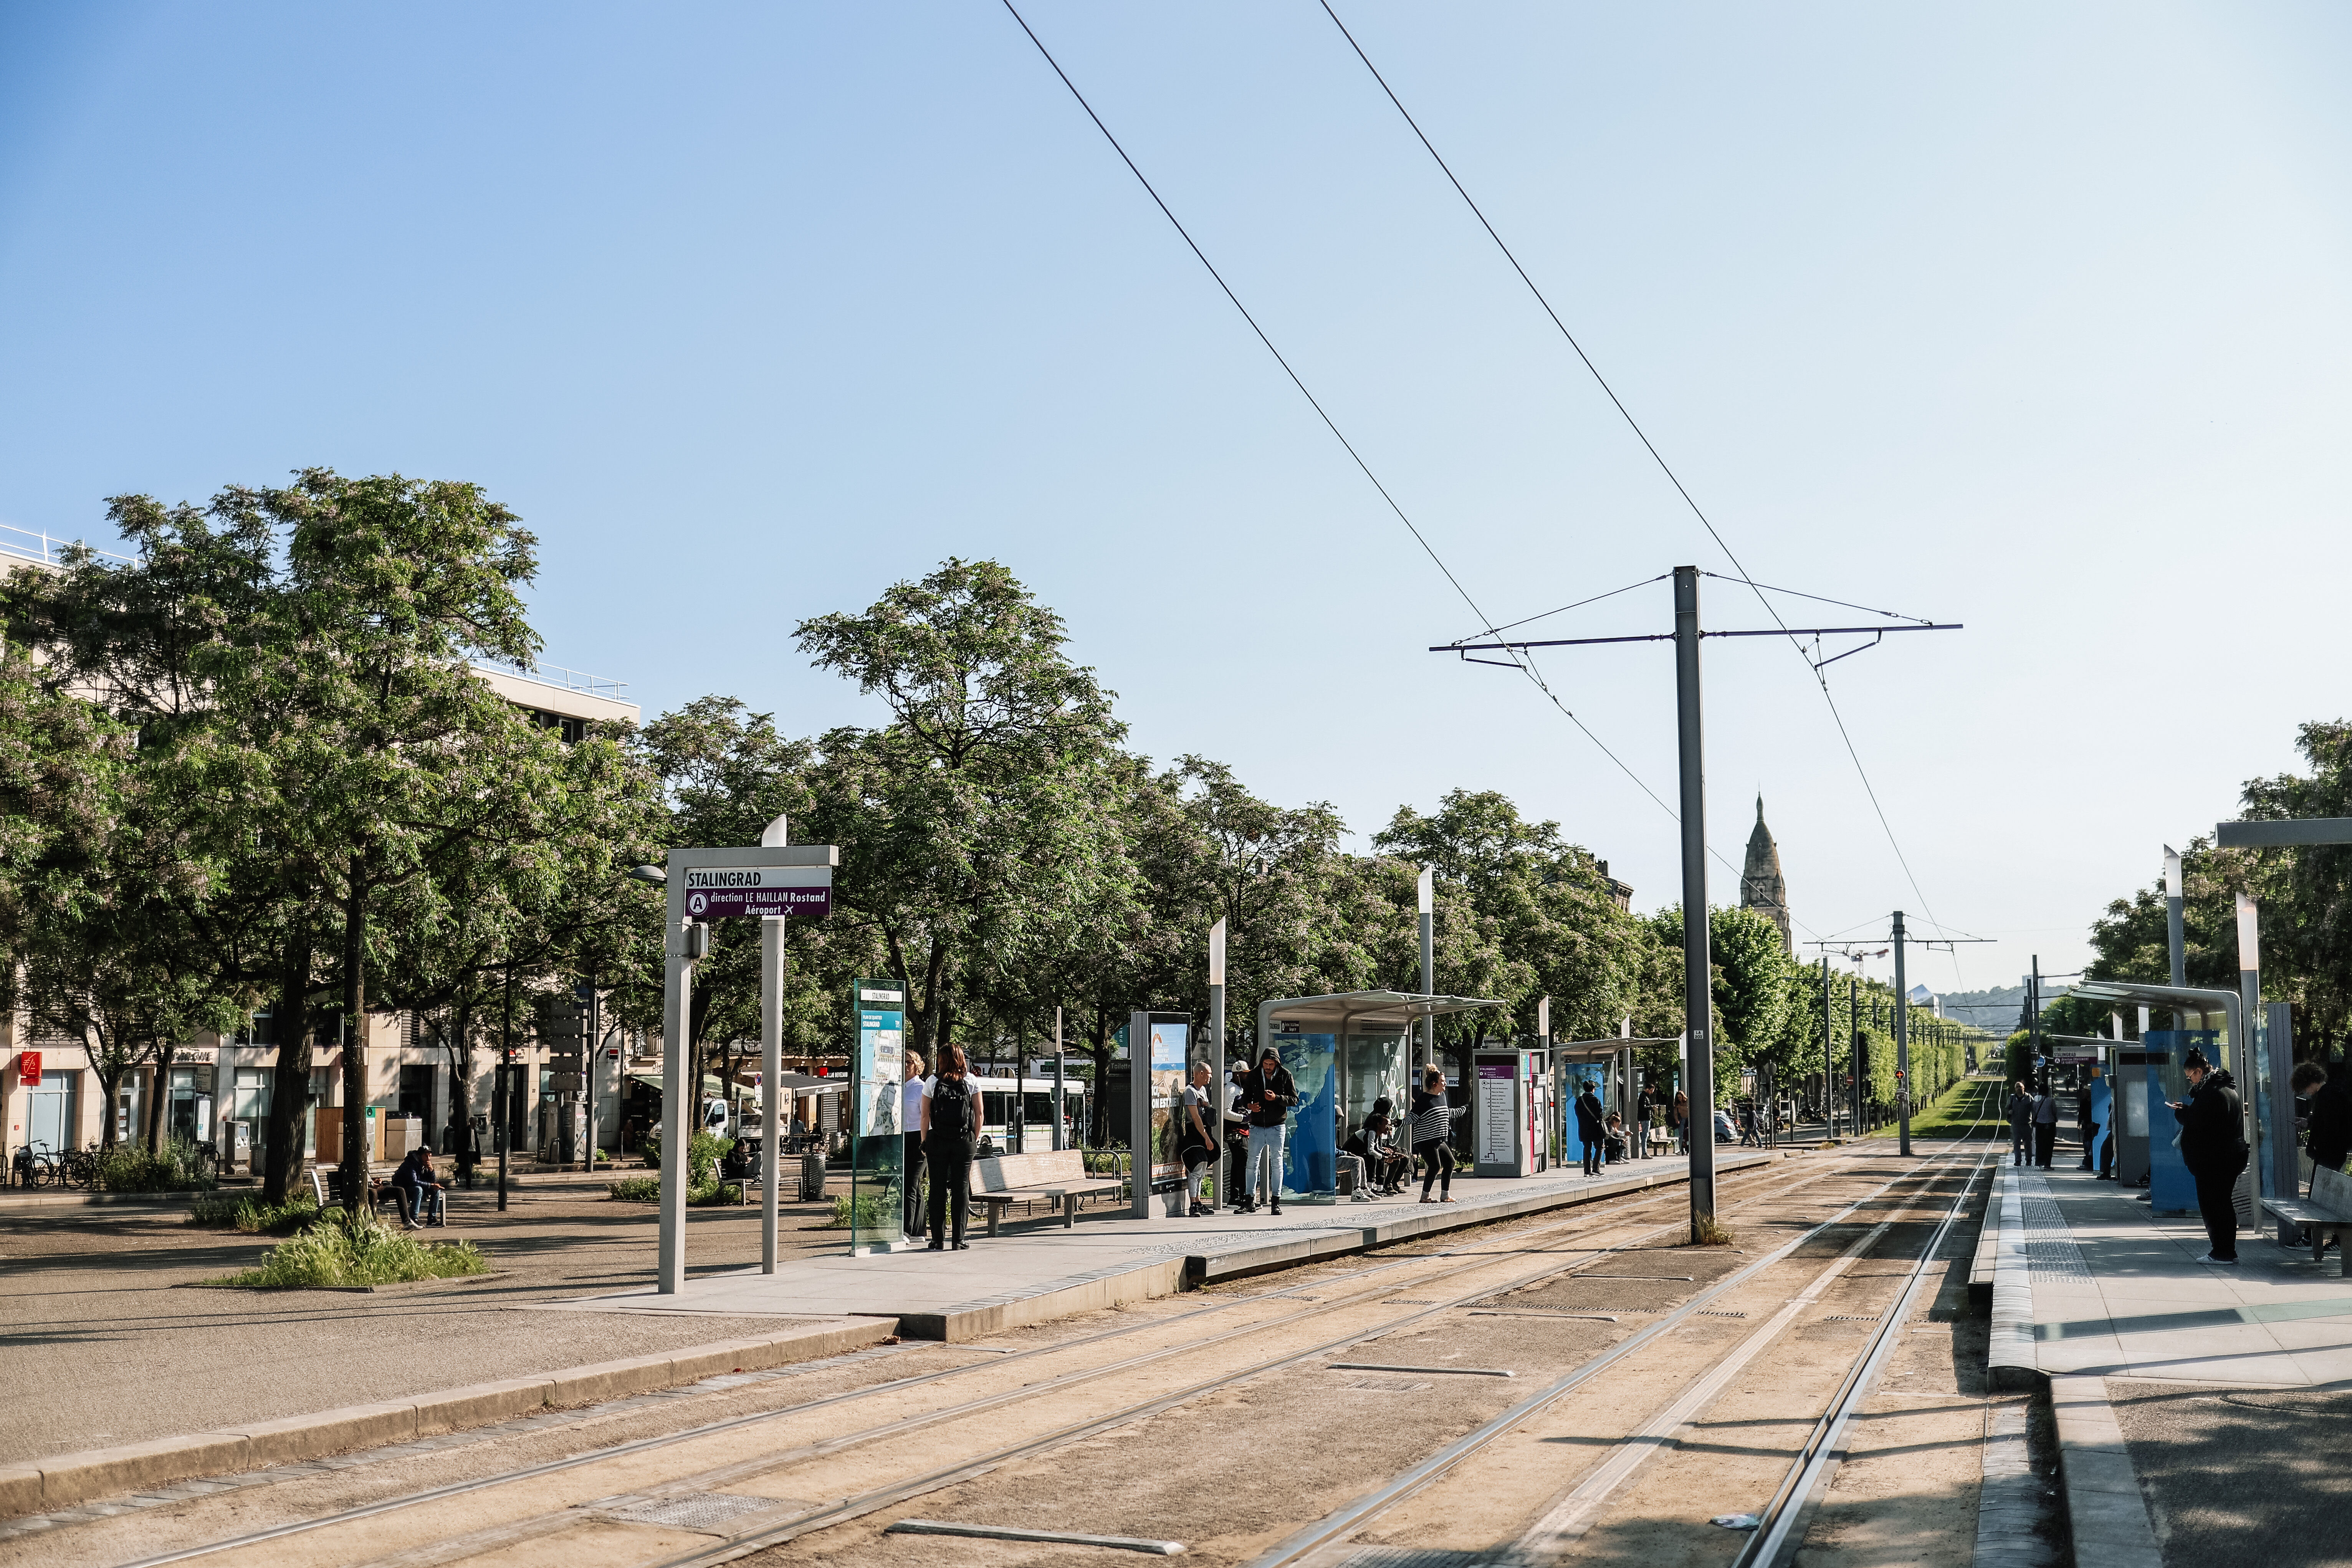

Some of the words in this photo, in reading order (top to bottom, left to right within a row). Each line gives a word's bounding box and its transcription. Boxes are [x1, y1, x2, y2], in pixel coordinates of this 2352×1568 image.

[688, 872, 761, 887] STALINGRAD
[711, 892, 743, 902] direction
[746, 893, 753, 902] LE
[756, 892, 787, 902] HAILLAN
[790, 891, 825, 902] Rostand
[693, 897, 703, 910] A
[745, 905, 781, 915] Aéroport
[1152, 1098, 1159, 1109] ON
[1159, 1098, 1169, 1108] EST
[1169, 1097, 1179, 1107] BIEN
